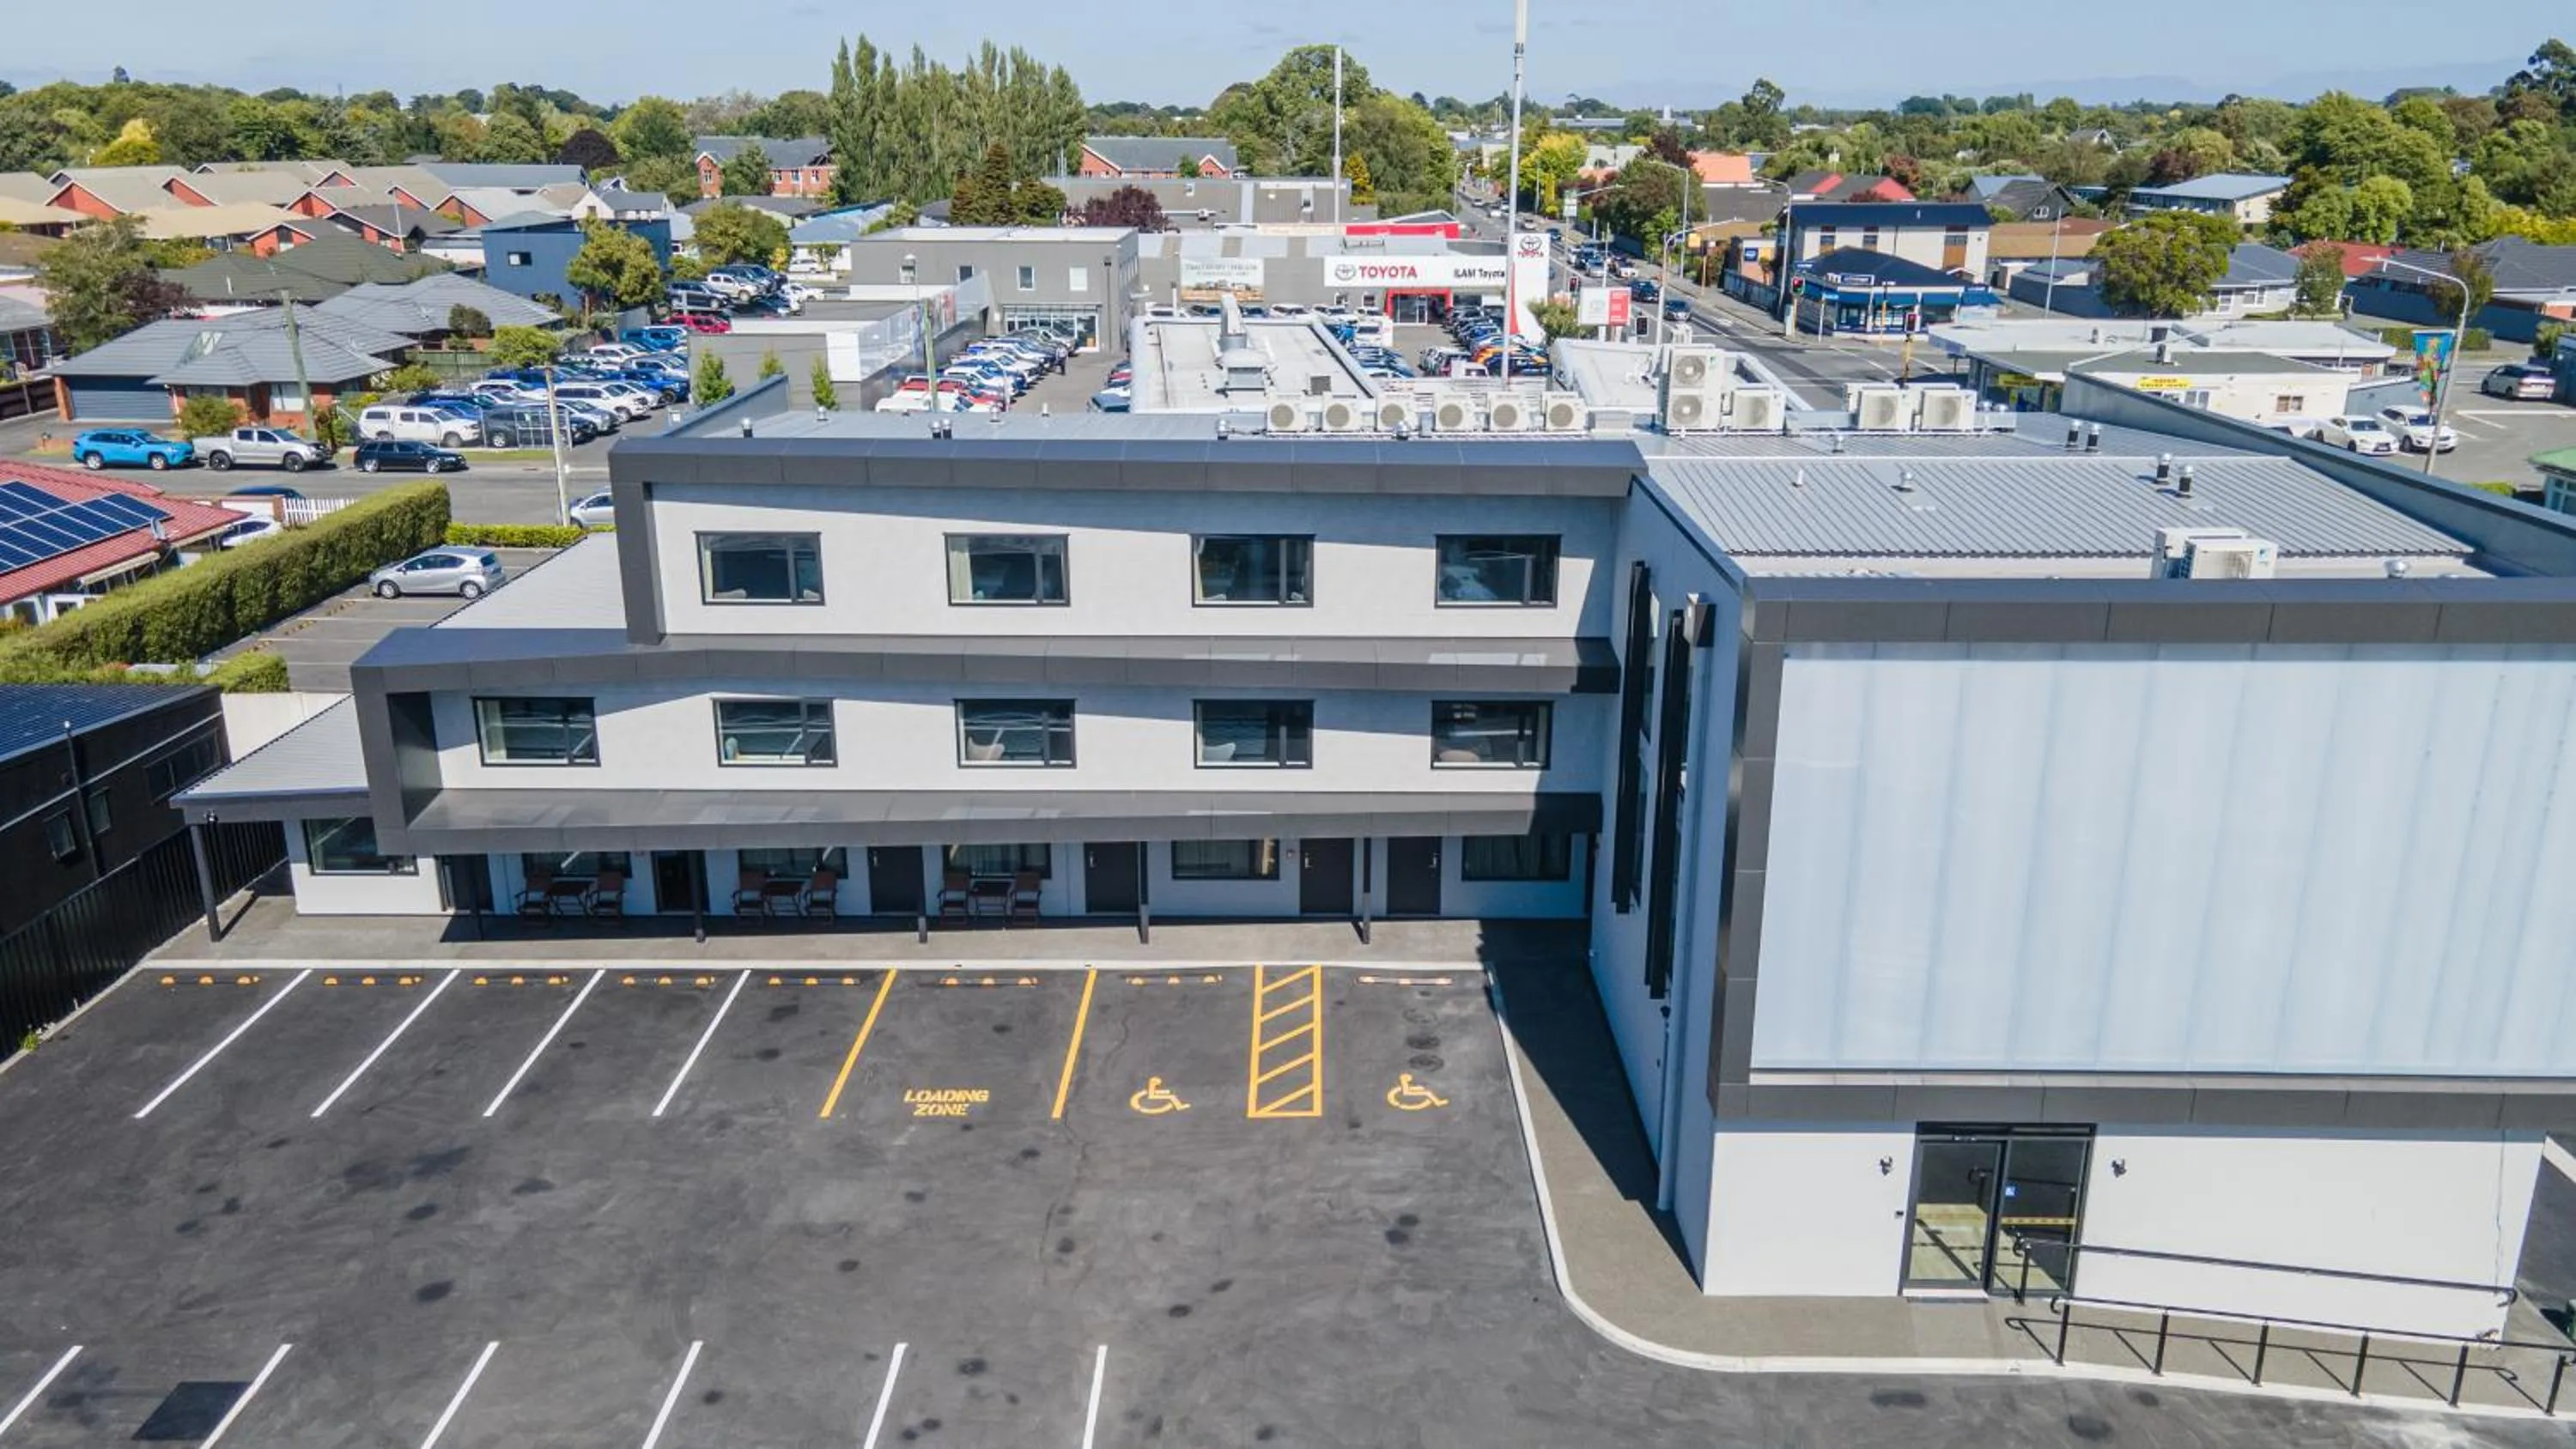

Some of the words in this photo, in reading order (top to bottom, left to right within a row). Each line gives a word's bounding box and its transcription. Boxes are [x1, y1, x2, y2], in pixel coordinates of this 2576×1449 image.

[1358, 265, 1418, 279] TOYOTA
[1478, 268, 1505, 280] Toyota
[903, 1088, 989, 1103] LOADING
[913, 1103, 970, 1116] ZONE
